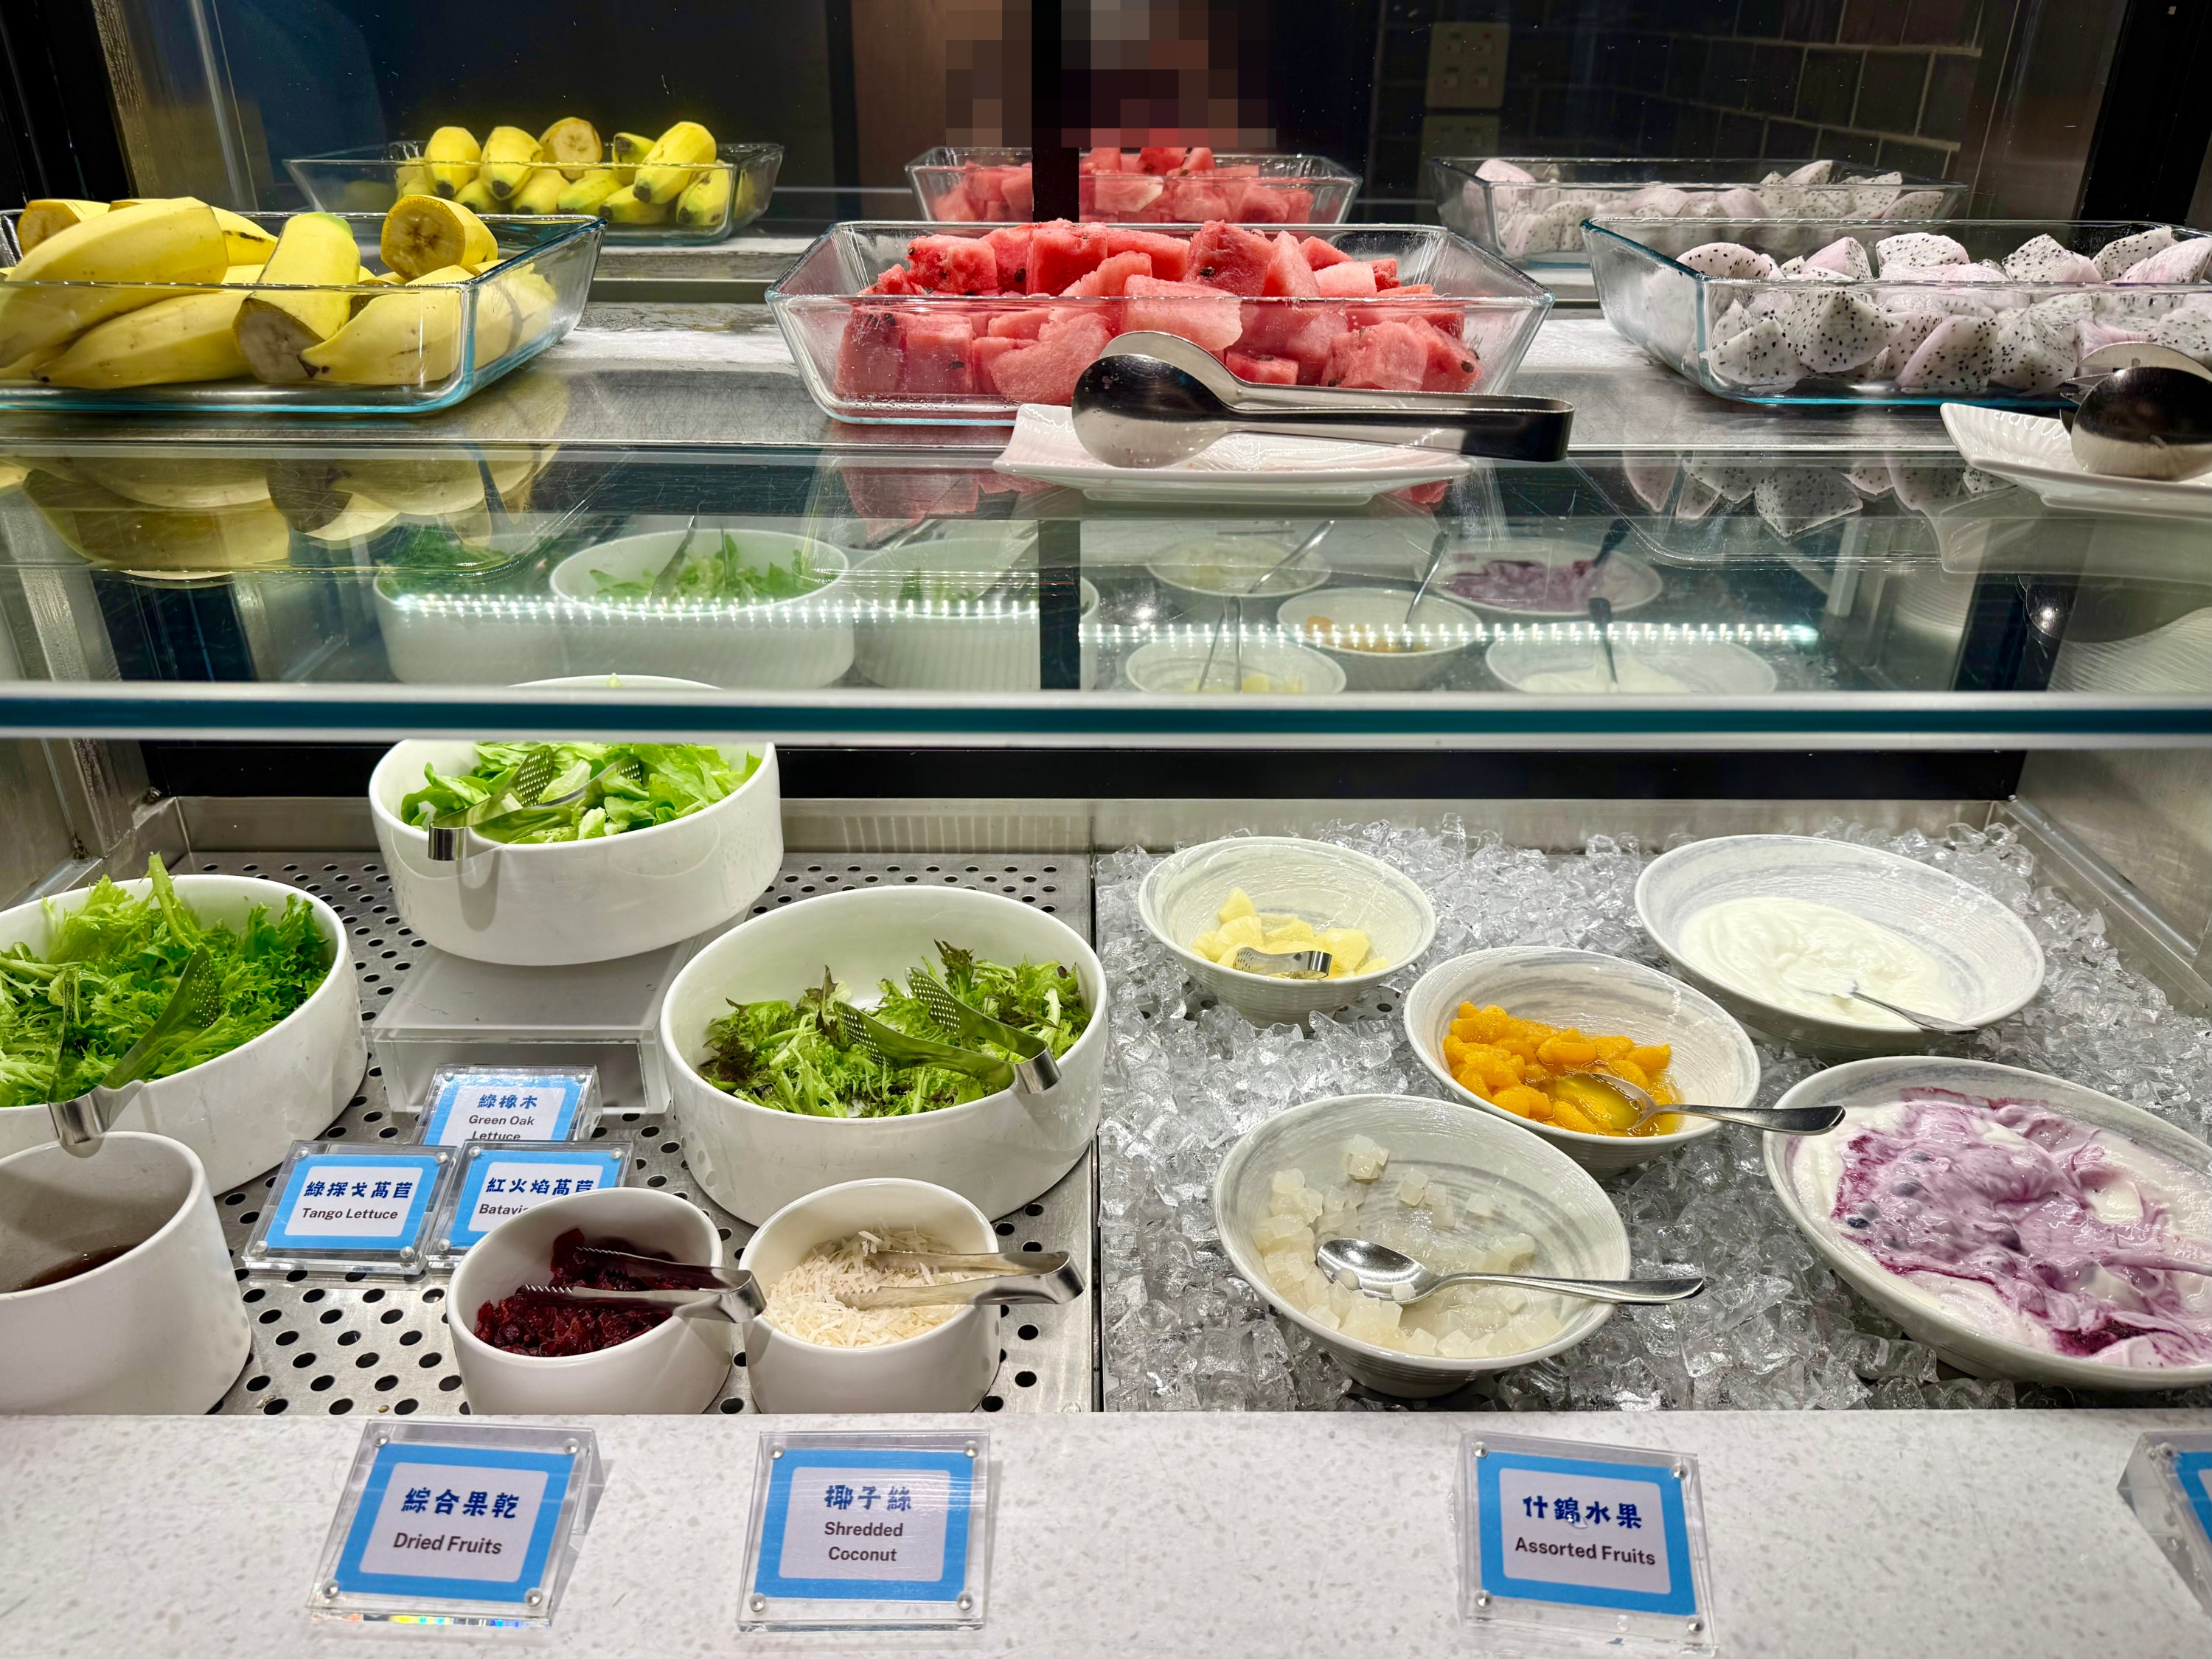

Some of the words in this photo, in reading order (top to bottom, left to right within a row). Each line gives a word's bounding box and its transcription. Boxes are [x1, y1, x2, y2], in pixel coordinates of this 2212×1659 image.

[477, 1093, 538, 1109] 綠橡木
[469, 1115, 507, 1124] Green
[509, 1116, 535, 1125] Oak
[472, 1130, 521, 1141] Lettuce
[302, 1208, 343, 1220] Tango
[345, 1208, 398, 1219] Lettuce
[401, 1486, 520, 1519] 綜合果乾
[824, 1484, 911, 1512] 椰子絲
[1523, 1495, 1642, 1528] 什錦水果
[824, 1521, 903, 1537] Shredded
[393, 1532, 445, 1551] Dried
[447, 1535, 502, 1554] Fruits
[1515, 1537, 1596, 1559] Assorted
[1601, 1545, 1655, 1565] Fruits
[828, 1546, 897, 1562] Coconut
